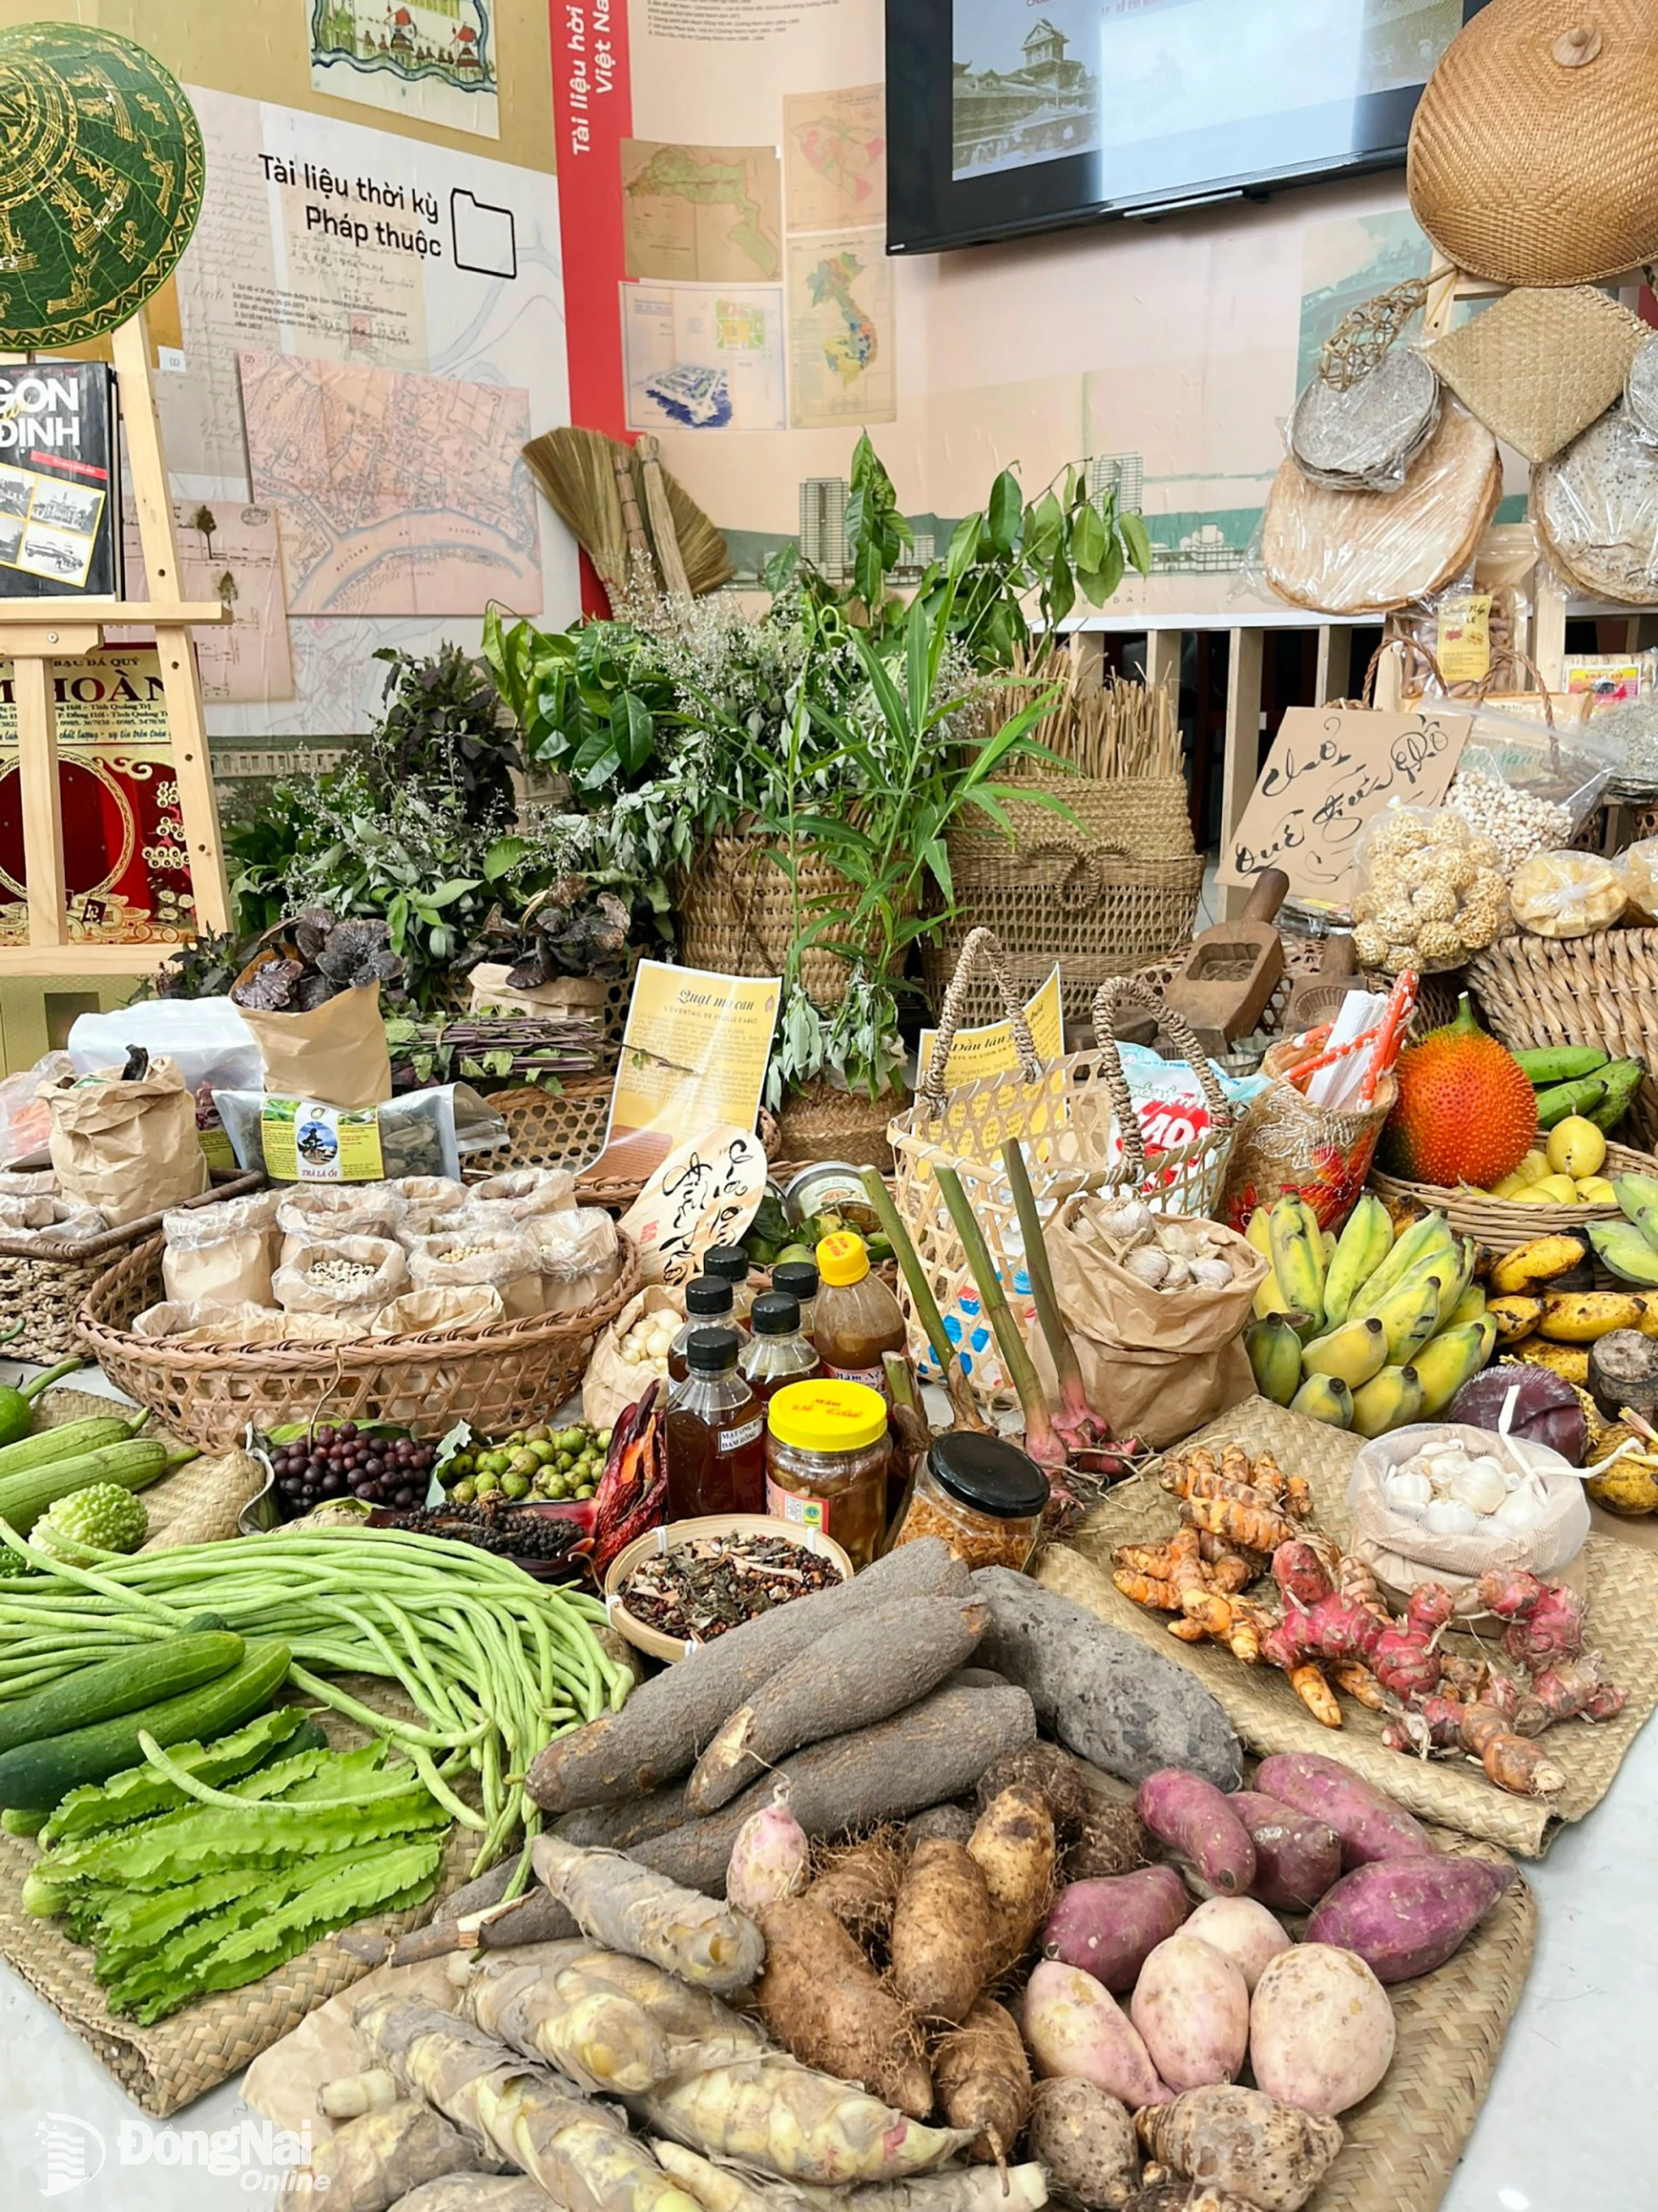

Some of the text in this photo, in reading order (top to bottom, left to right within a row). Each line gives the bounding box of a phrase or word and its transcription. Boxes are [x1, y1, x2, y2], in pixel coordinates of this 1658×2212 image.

[565, 4, 591, 155] Tài liệu hời
[593, 38, 616, 94] Việt
[258, 153, 440, 225] Tài liệu thời kỳ
[305, 205, 442, 259] Pháp thuộc
